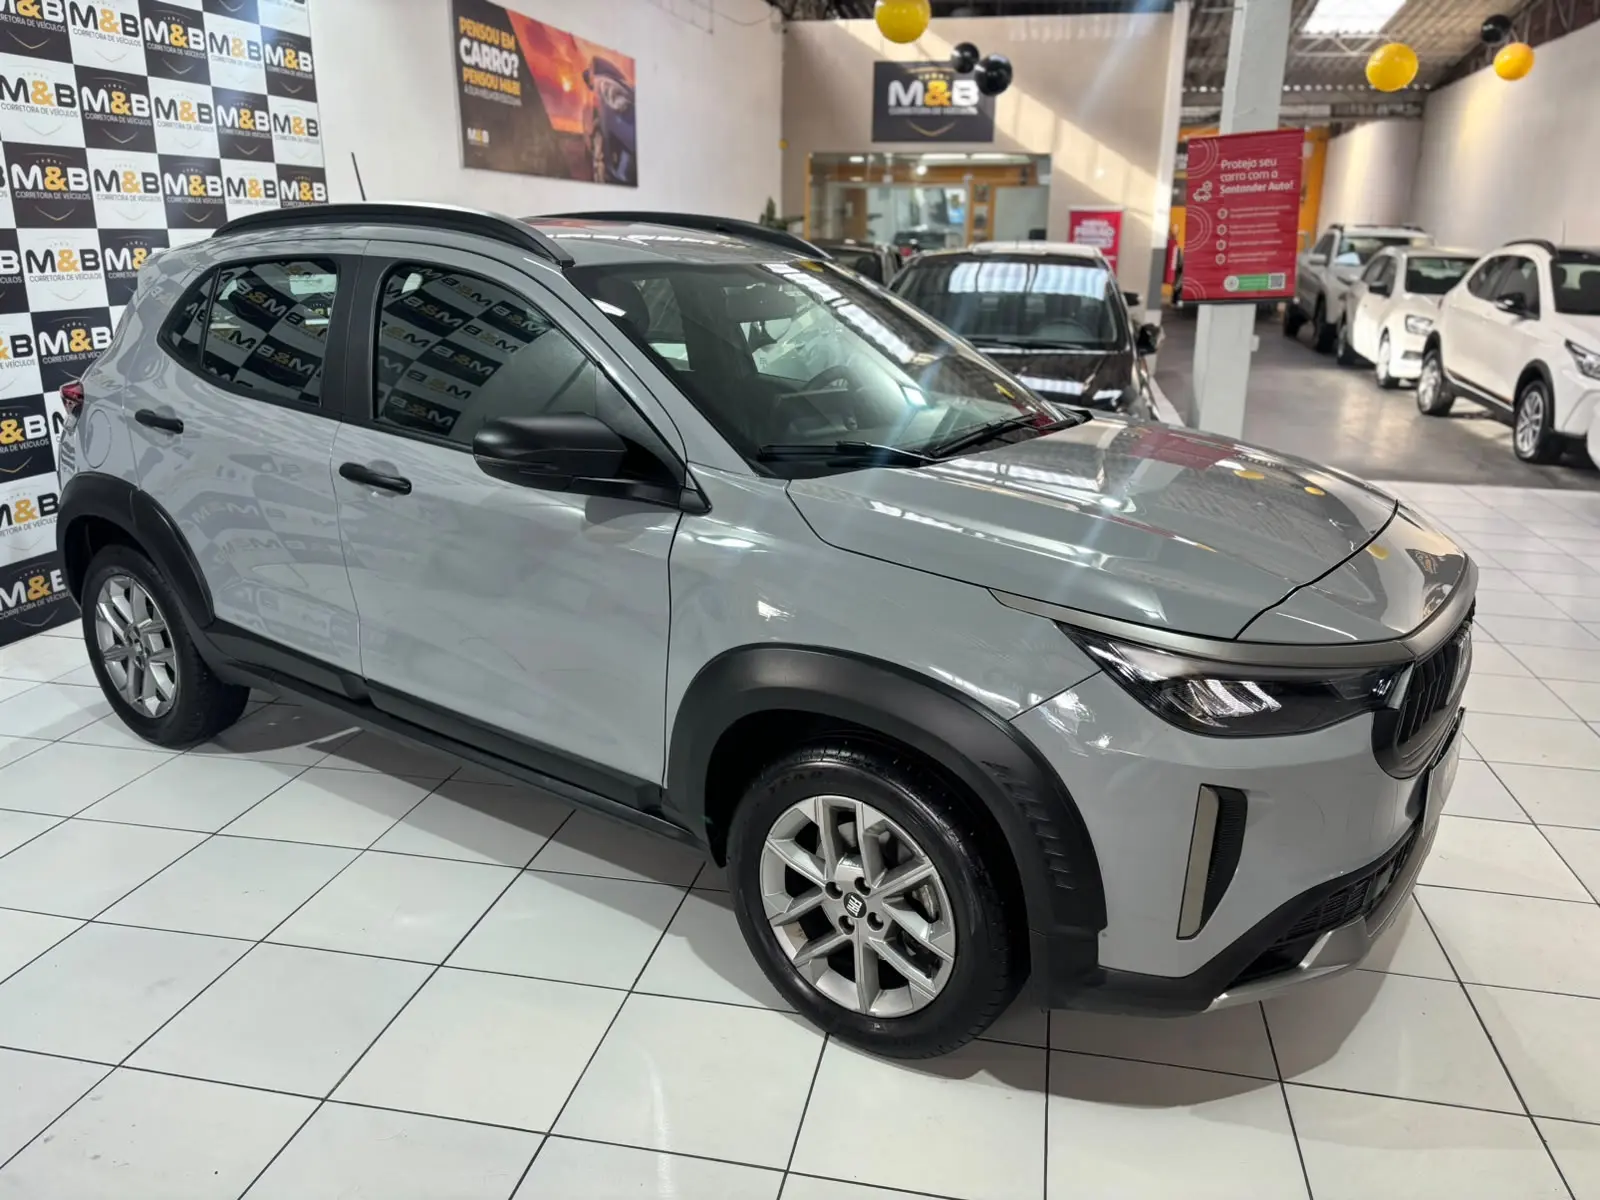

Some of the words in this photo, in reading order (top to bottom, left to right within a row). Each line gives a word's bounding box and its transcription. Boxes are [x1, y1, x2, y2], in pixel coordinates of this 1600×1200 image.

[0, 0, 64, 22] &B
[0, 13, 26, 25] RETORA
[69, 1, 140, 38] M&B
[73, 27, 107, 41] CORRETORA
[143, 18, 206, 51] M&B
[459, 16, 500, 45] PENSOU
[209, 31, 262, 62] M&B
[264, 43, 313, 73] M&B
[460, 37, 520, 78] CARRO?
[0, 74, 77, 108] M&B
[81, 86, 150, 118] M&B
[888, 79, 979, 107] M&B
[1, 102, 39, 115] CORRETORA
[154, 96, 214, 124] M&B
[217, 105, 270, 132] M&B
[273, 113, 319, 137] M&B
[1247, 171, 1269, 180] com
[1258, 158, 1278, 167] seu
[10, 163, 89, 192] M&B
[93, 168, 160, 194] M&B
[163, 172, 223, 197] M&B
[226, 176, 277, 199] M&B
[280, 179, 327, 202] M&B
[1220, 182, 1267, 194] Santander
[15, 190, 53, 199] CORRETORA
[25, 248, 100, 274] M&B
[104, 247, 165, 270] M&
[0, 275, 22, 284] CULOS
[29, 274, 66, 283] CORRETORA
[38, 326, 113, 356] M&B
[0, 414, 47, 444] &B
